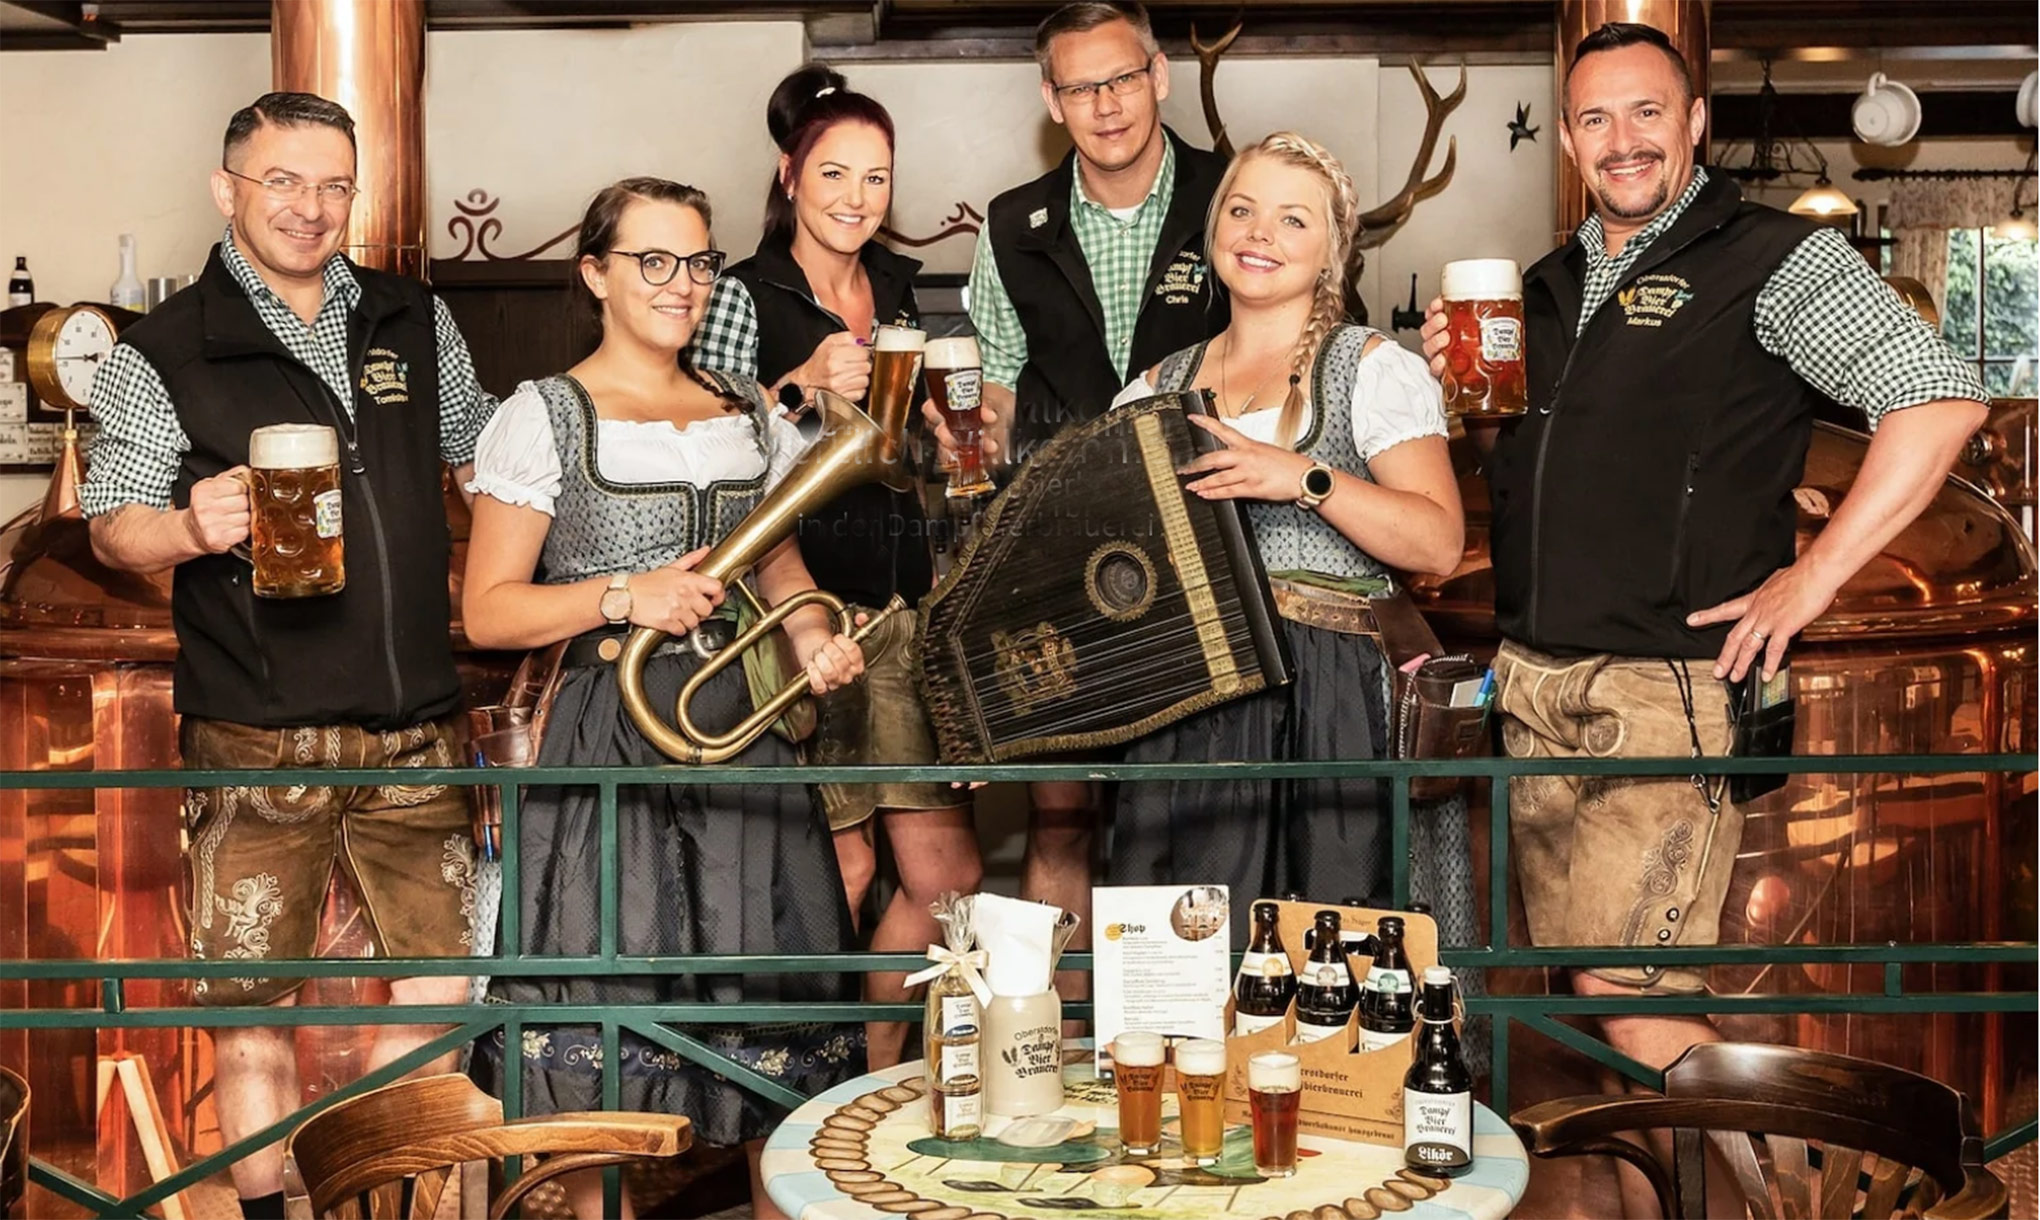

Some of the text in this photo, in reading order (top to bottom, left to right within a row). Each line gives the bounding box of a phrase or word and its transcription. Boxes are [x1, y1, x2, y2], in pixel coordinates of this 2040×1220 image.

[1167, 262, 1194, 276] ampf
[1165, 294, 1189, 305] Chris
[1625, 316, 1663, 328] Markus
[1118, 923, 1147, 934] Shop
[1028, 1053, 1051, 1066] Bier
[1419, 1105, 1451, 1117] Dampf
[1424, 1115, 1447, 1126] Bier
[1416, 1123, 1457, 1136] Brauerei
[1418, 1146, 1454, 1161] Likör
